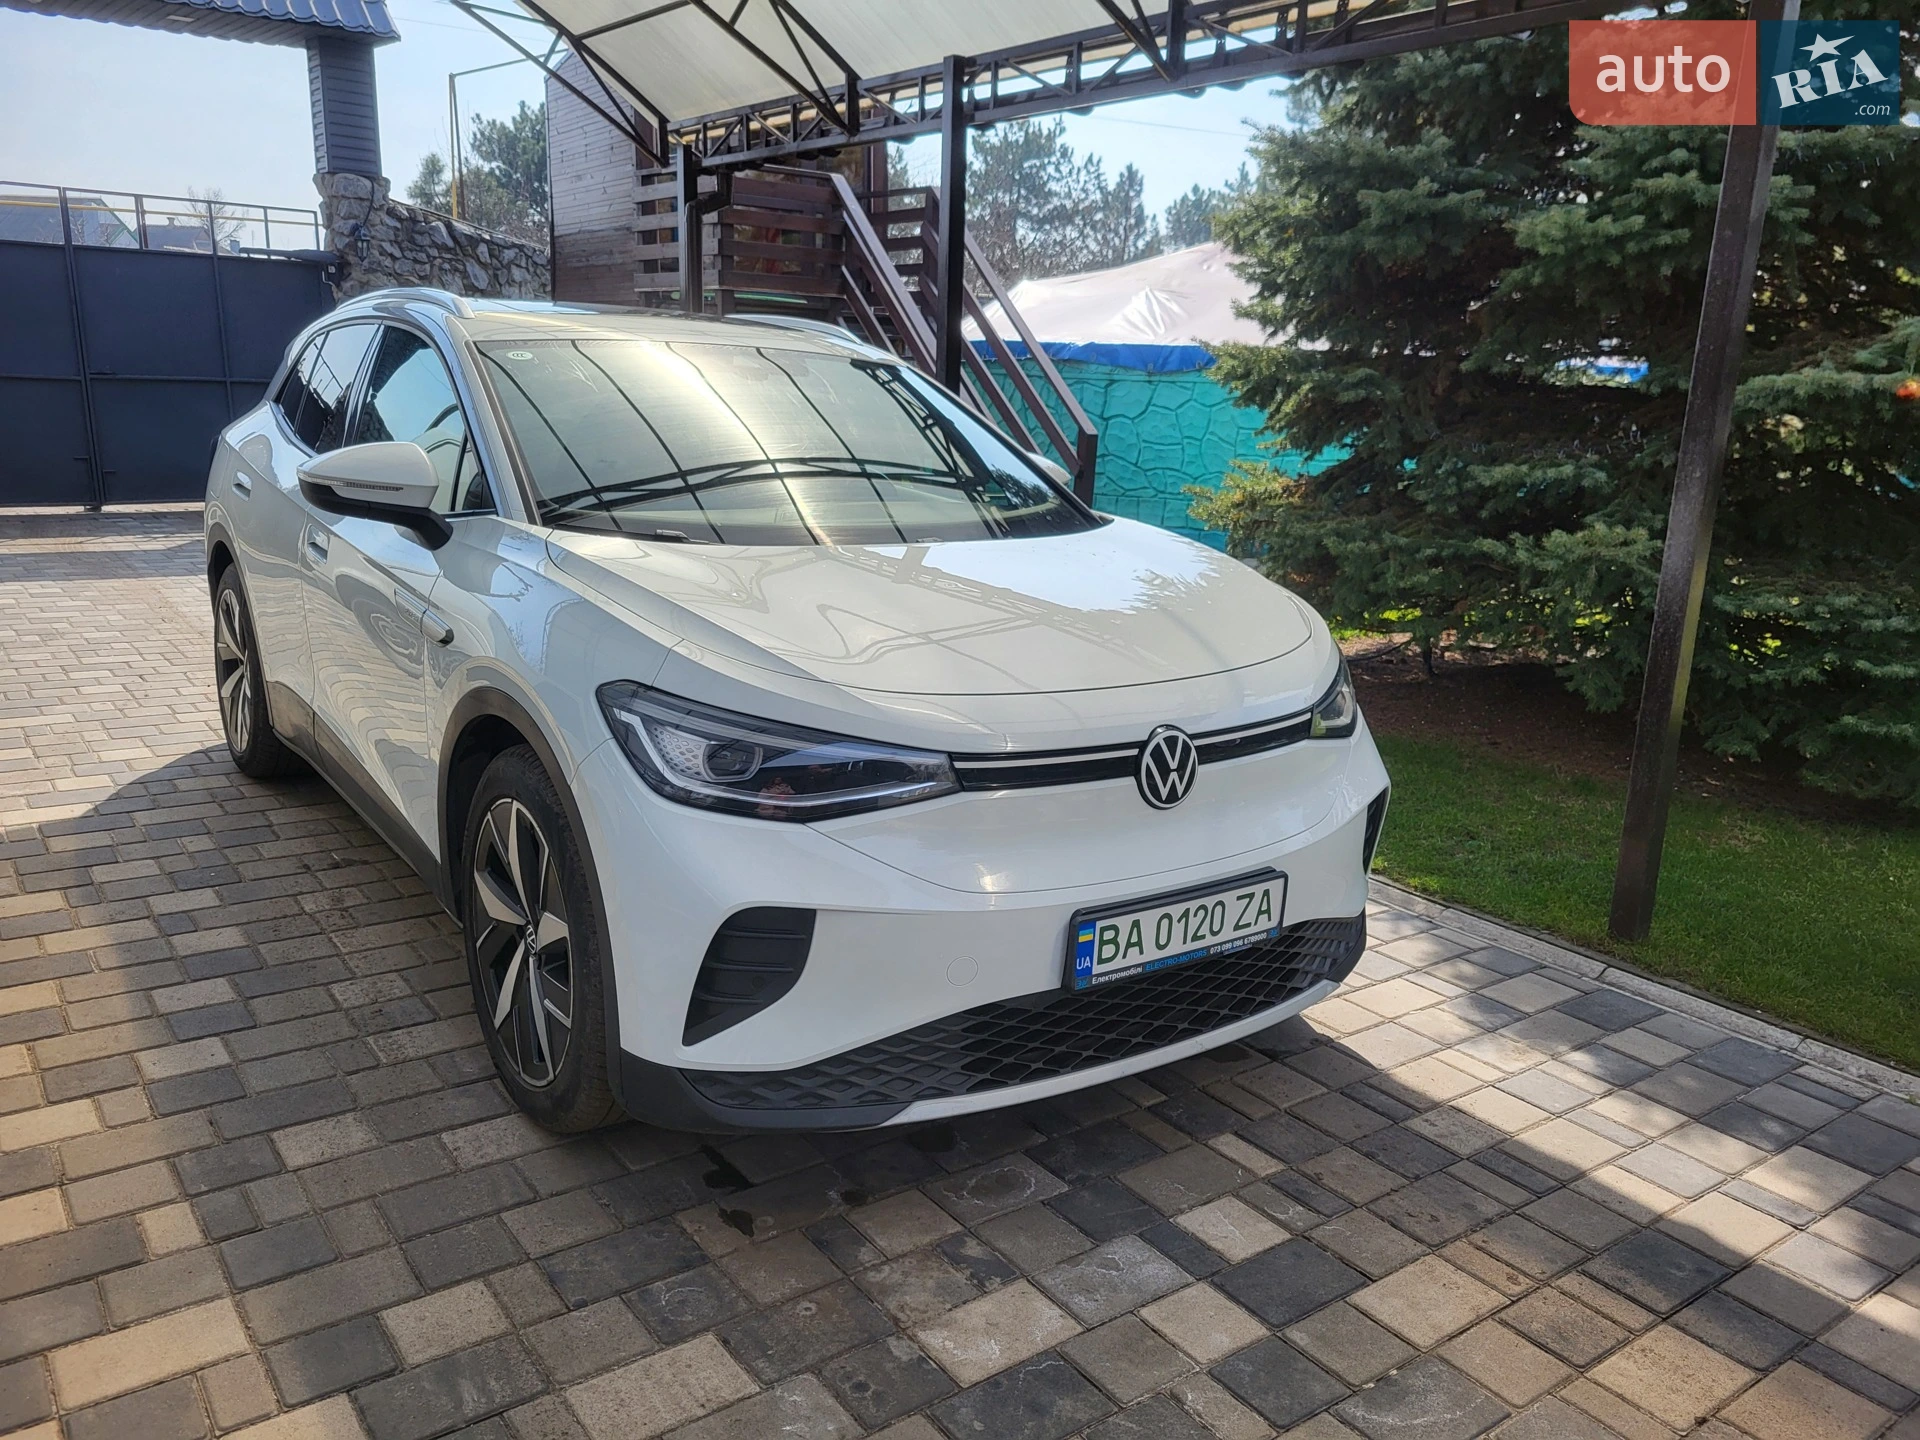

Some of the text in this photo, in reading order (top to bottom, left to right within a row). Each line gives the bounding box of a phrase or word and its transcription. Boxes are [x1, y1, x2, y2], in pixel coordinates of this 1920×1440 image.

[1096, 888, 1272, 966] BA 0120 ZA
[1076, 956, 1091, 970] UA
[1091, 965, 1143, 985] Електромобілі
[1209, 945, 1221, 954] 073
